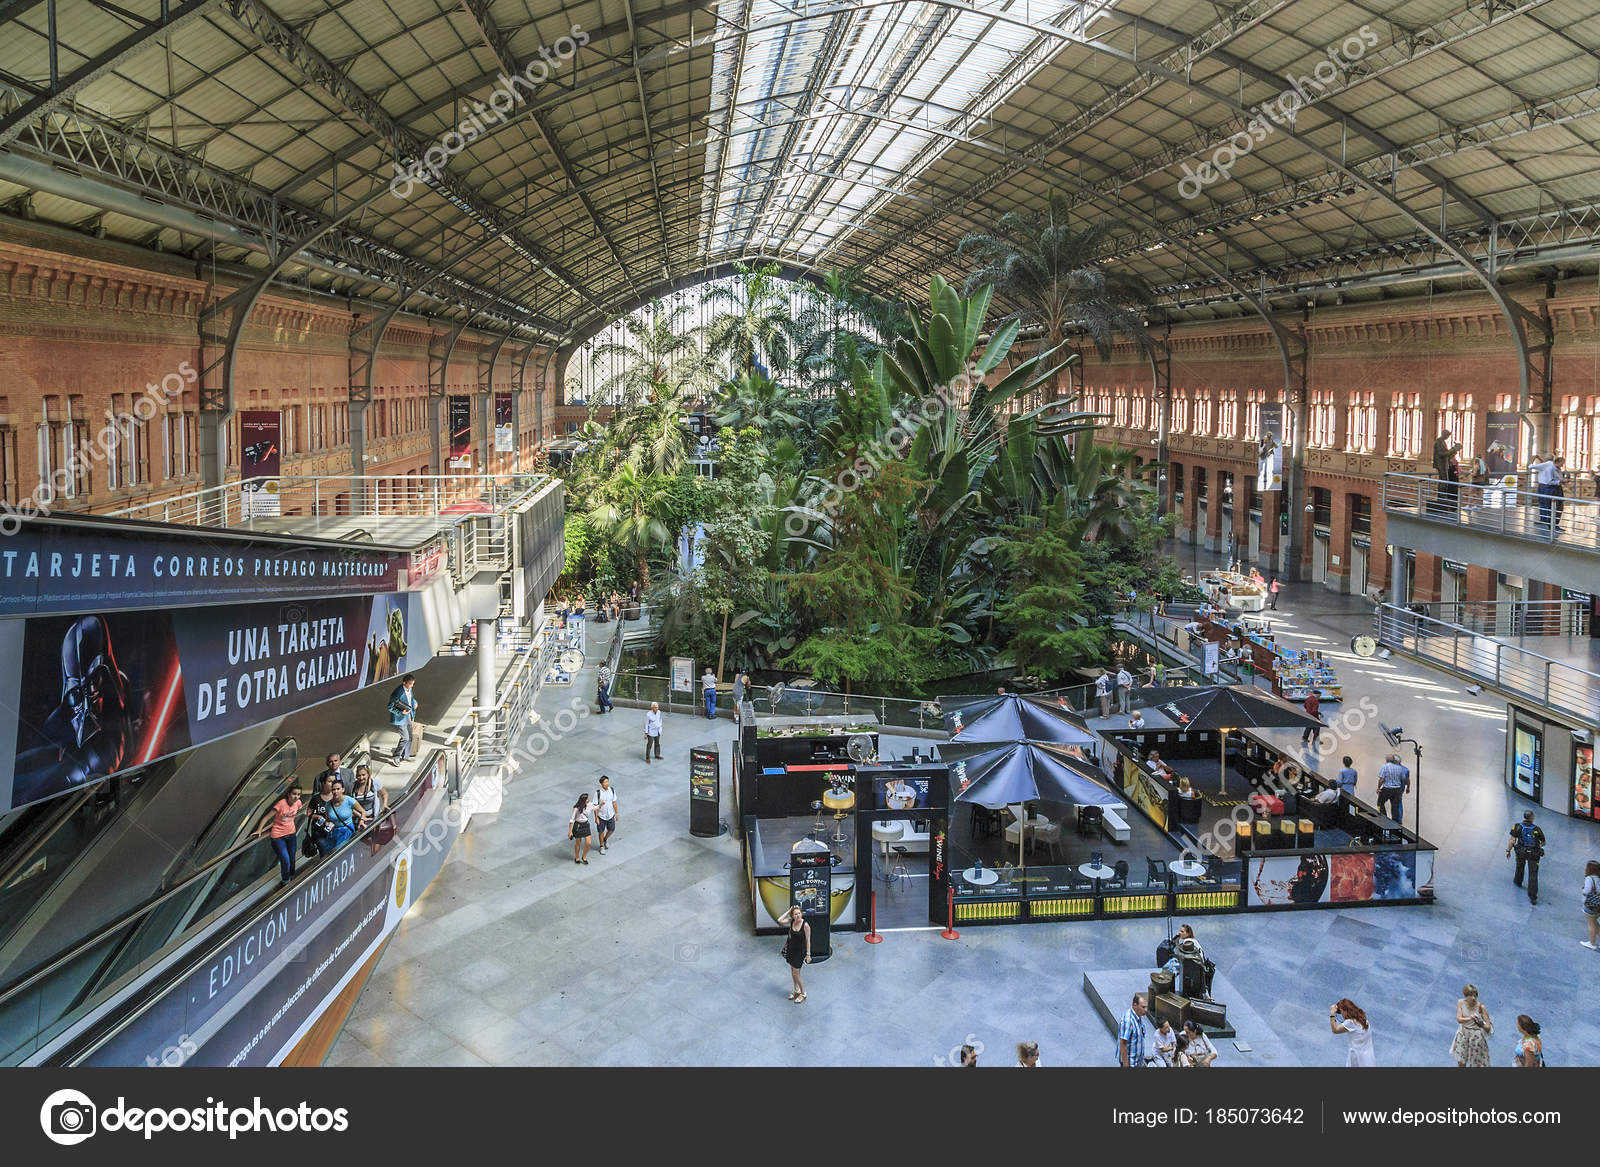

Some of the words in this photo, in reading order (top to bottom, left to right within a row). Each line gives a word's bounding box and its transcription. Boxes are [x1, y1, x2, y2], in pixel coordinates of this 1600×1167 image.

[3, 551, 136, 577] TARJETA
[153, 556, 244, 577] CORREOS
[254, 558, 316, 577] PREPAGO
[228, 626, 270, 665] UNA
[278, 617, 344, 655] TARJETA
[197, 678, 228, 721] DE
[236, 665, 289, 709] OTRA
[296, 649, 357, 691] GALAXIA
[936, 840, 944, 862] WINE
[807, 869, 815, 879] 2
[209, 907, 288, 999] EDICIÓN
[296, 853, 355, 922] LIMITADA
